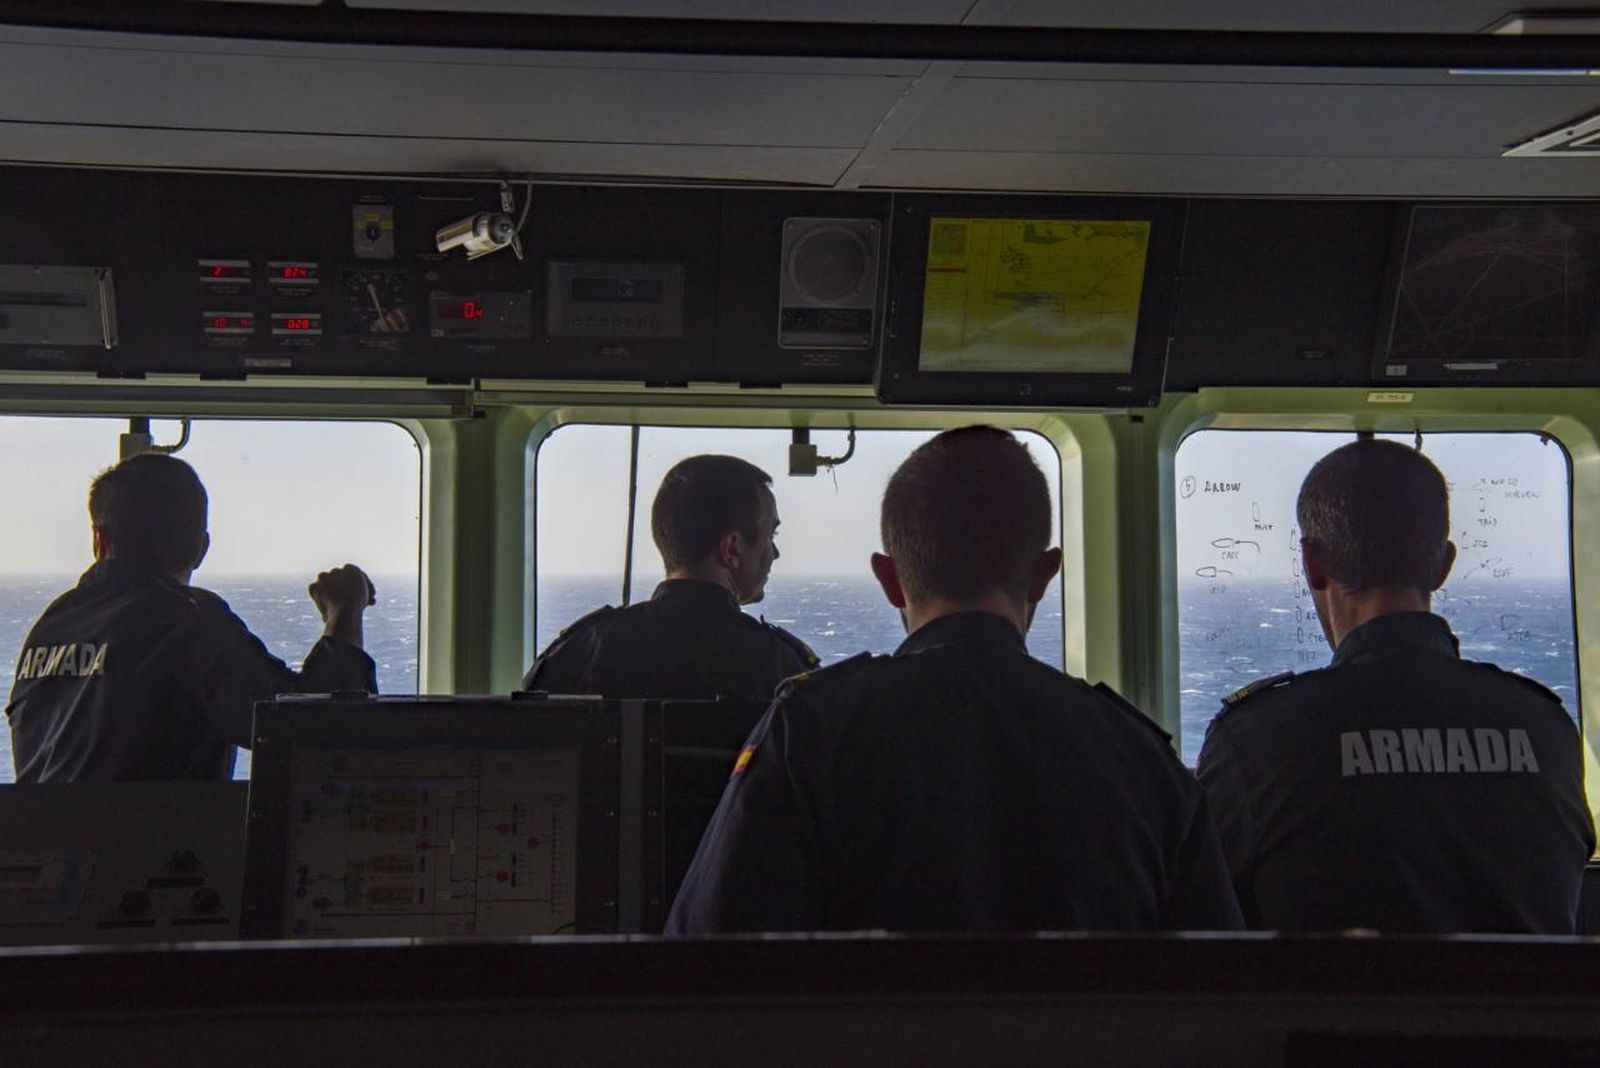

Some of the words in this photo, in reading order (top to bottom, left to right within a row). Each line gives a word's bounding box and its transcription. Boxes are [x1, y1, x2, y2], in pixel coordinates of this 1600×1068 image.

[1204, 480, 1241, 493] ARROW
[17, 642, 108, 681] ARMADA
[1340, 727, 1540, 777] ARMADA
